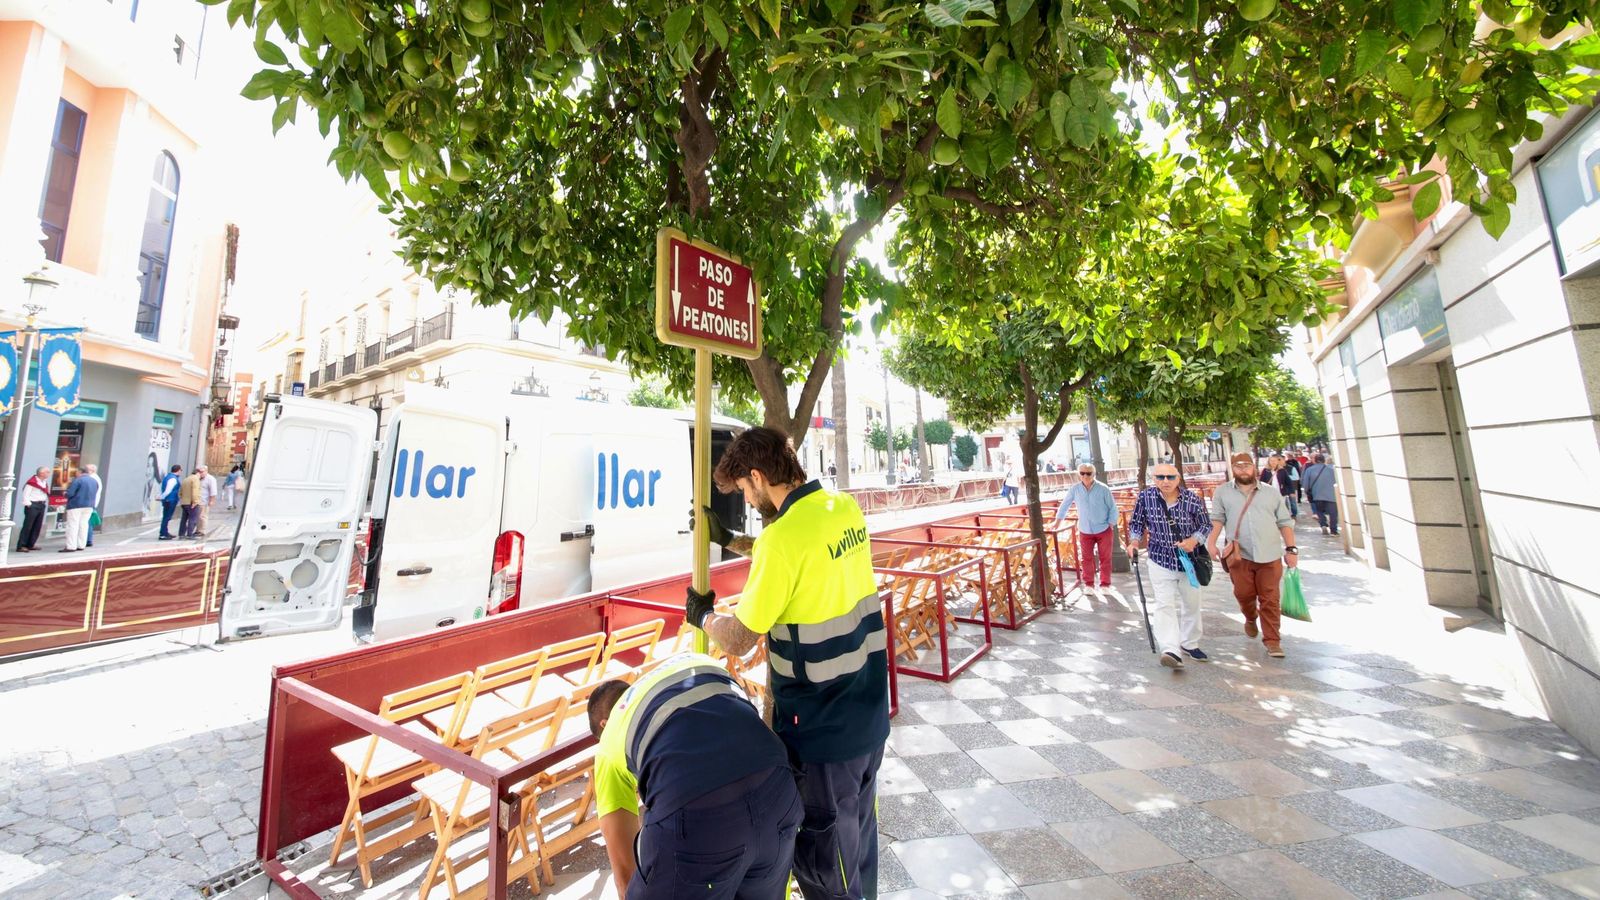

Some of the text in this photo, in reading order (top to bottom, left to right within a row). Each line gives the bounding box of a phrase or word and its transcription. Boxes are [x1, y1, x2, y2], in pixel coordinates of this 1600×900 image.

[700, 257, 732, 286] PASO
[708, 286, 724, 310] DE
[683, 306, 748, 341] PEATONES
[393, 448, 476, 499] llar
[597, 452, 662, 510] llar
